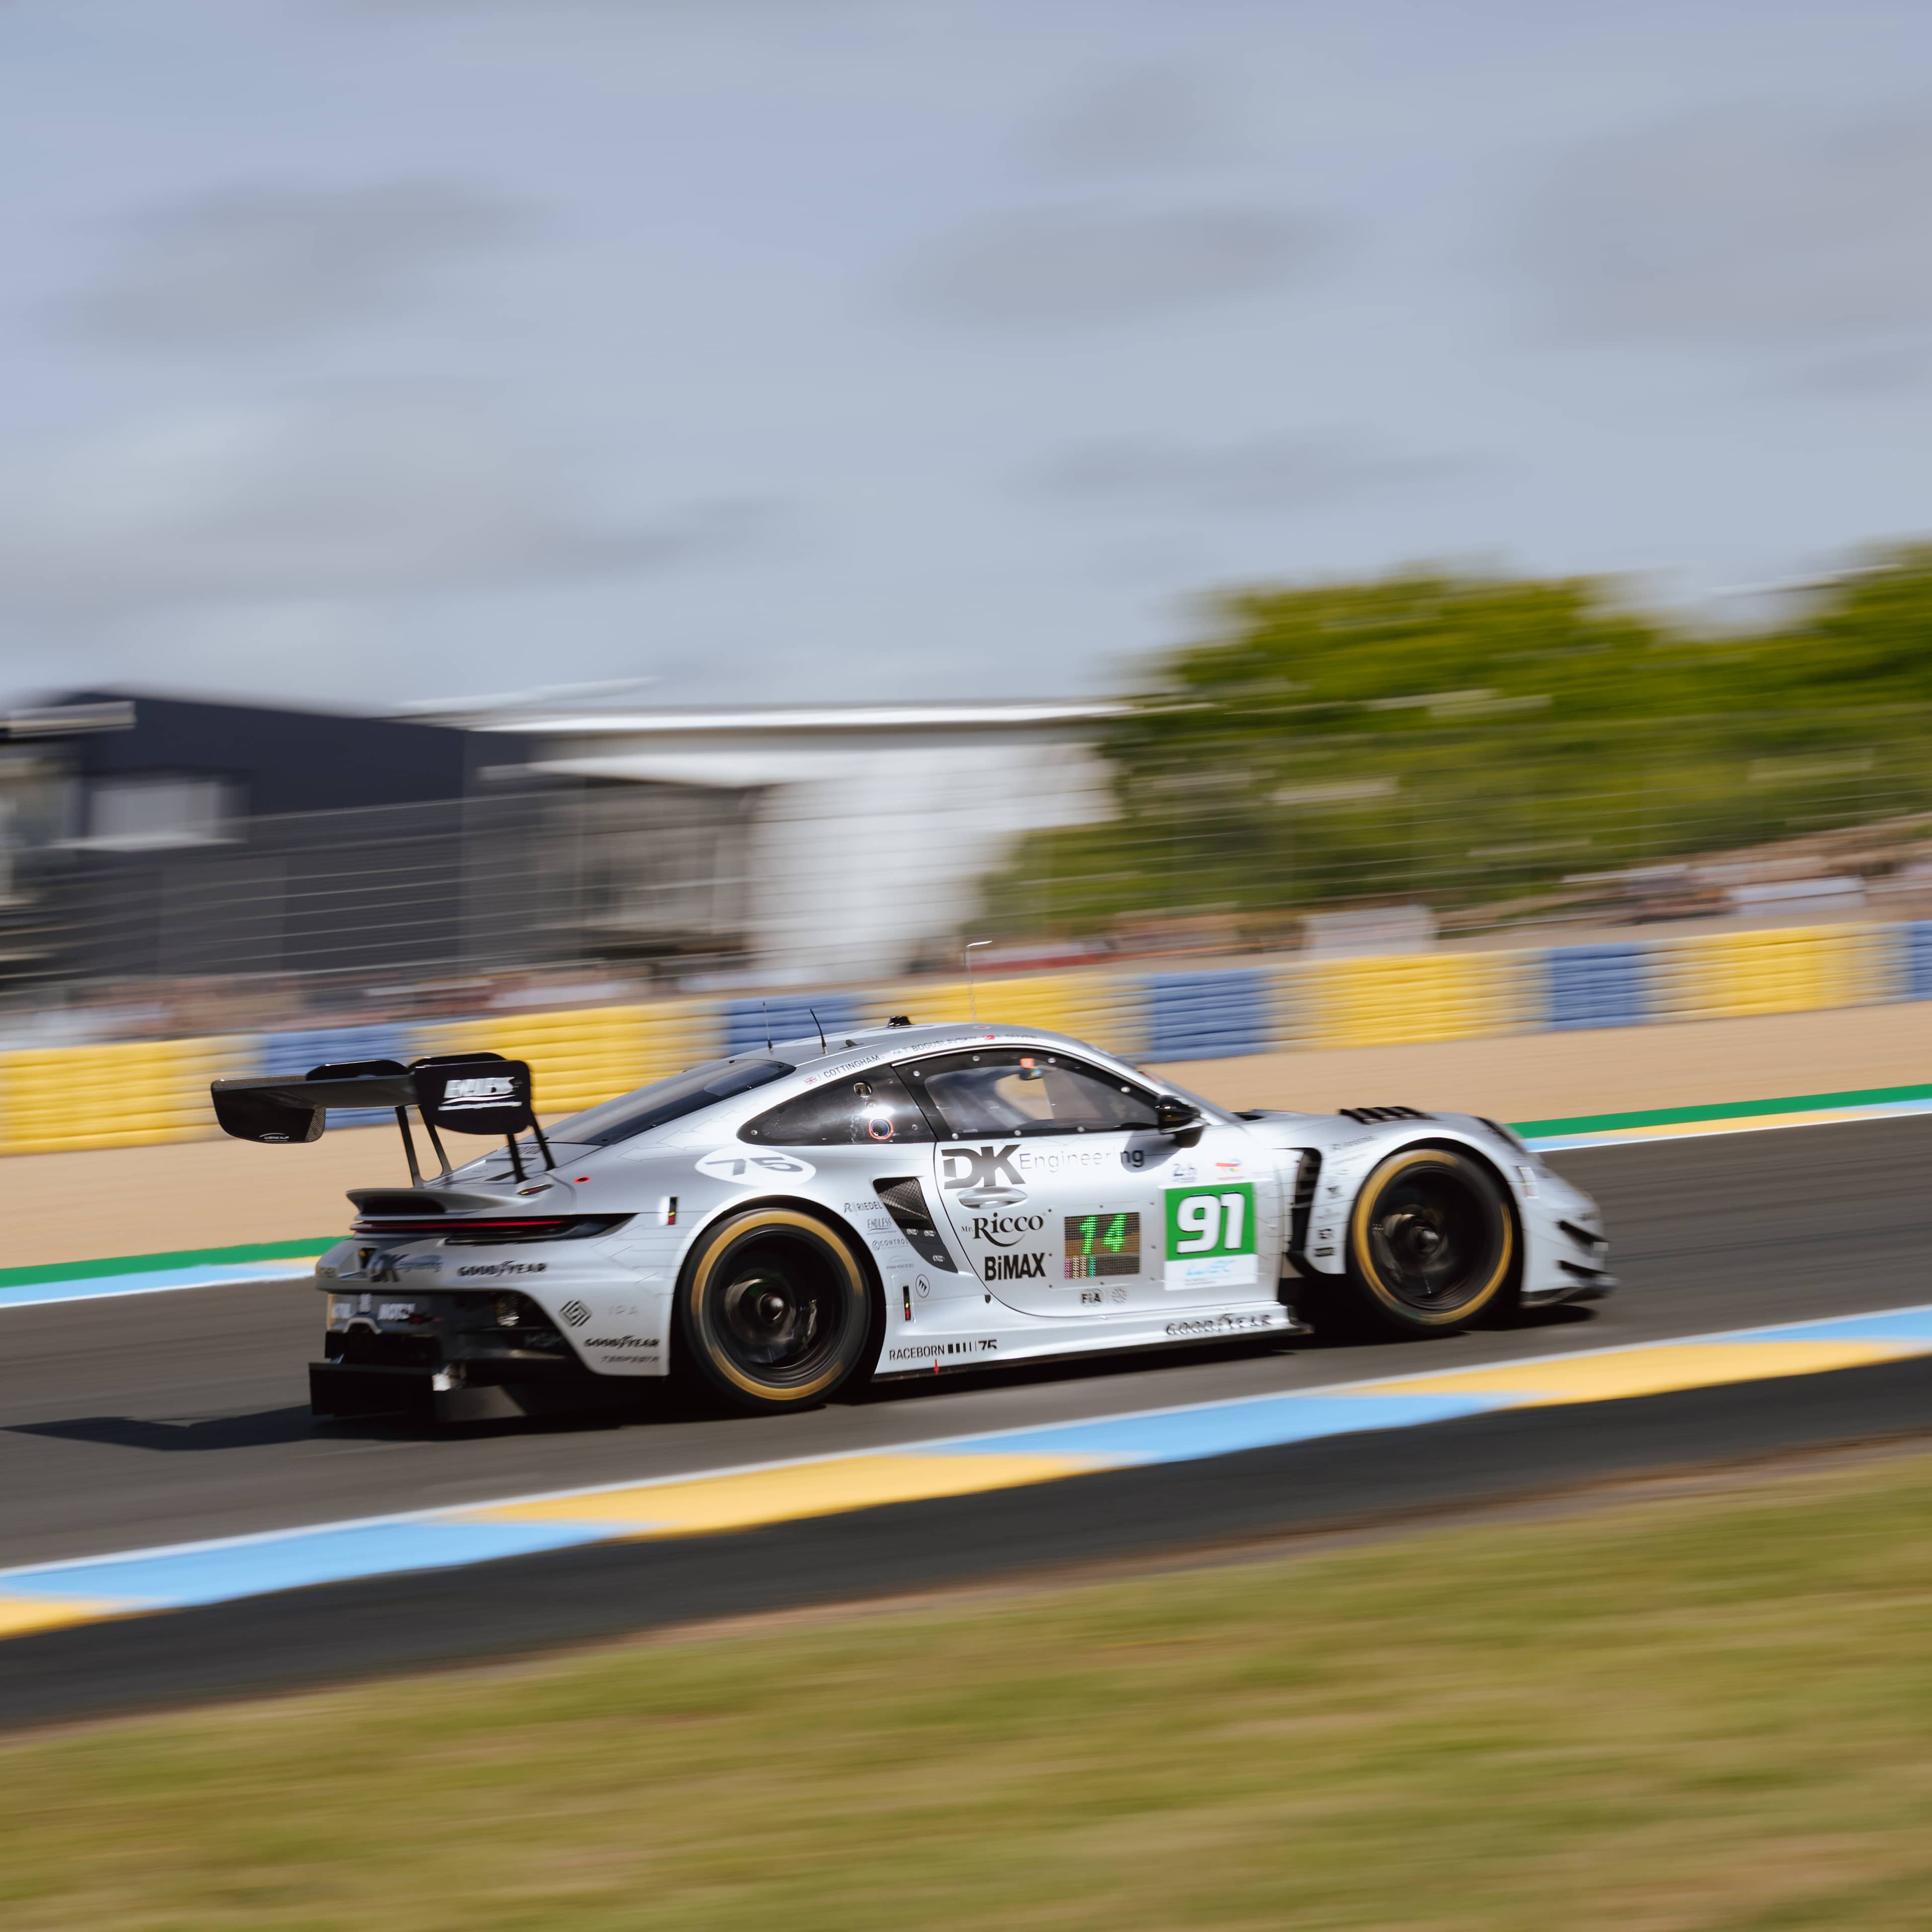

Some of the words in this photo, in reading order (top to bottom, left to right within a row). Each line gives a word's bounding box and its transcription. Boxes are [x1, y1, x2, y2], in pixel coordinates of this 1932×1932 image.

[824, 1055, 880, 1078] COTTINGHAM
[704, 1157, 803, 1176] 75
[941, 1144, 1026, 1189] DK
[1019, 1149, 1144, 1173] Engineerng
[856, 1201, 883, 1211] RIEDEL
[867, 1217, 893, 1230] ENDLESS
[1176, 1191, 1246, 1254] 91
[1078, 1213, 1128, 1255] 14
[457, 1260, 548, 1277] GOODYEAR
[985, 1252, 1046, 1281] BiMAX
[889, 1344, 945, 1360] RACEBORN
